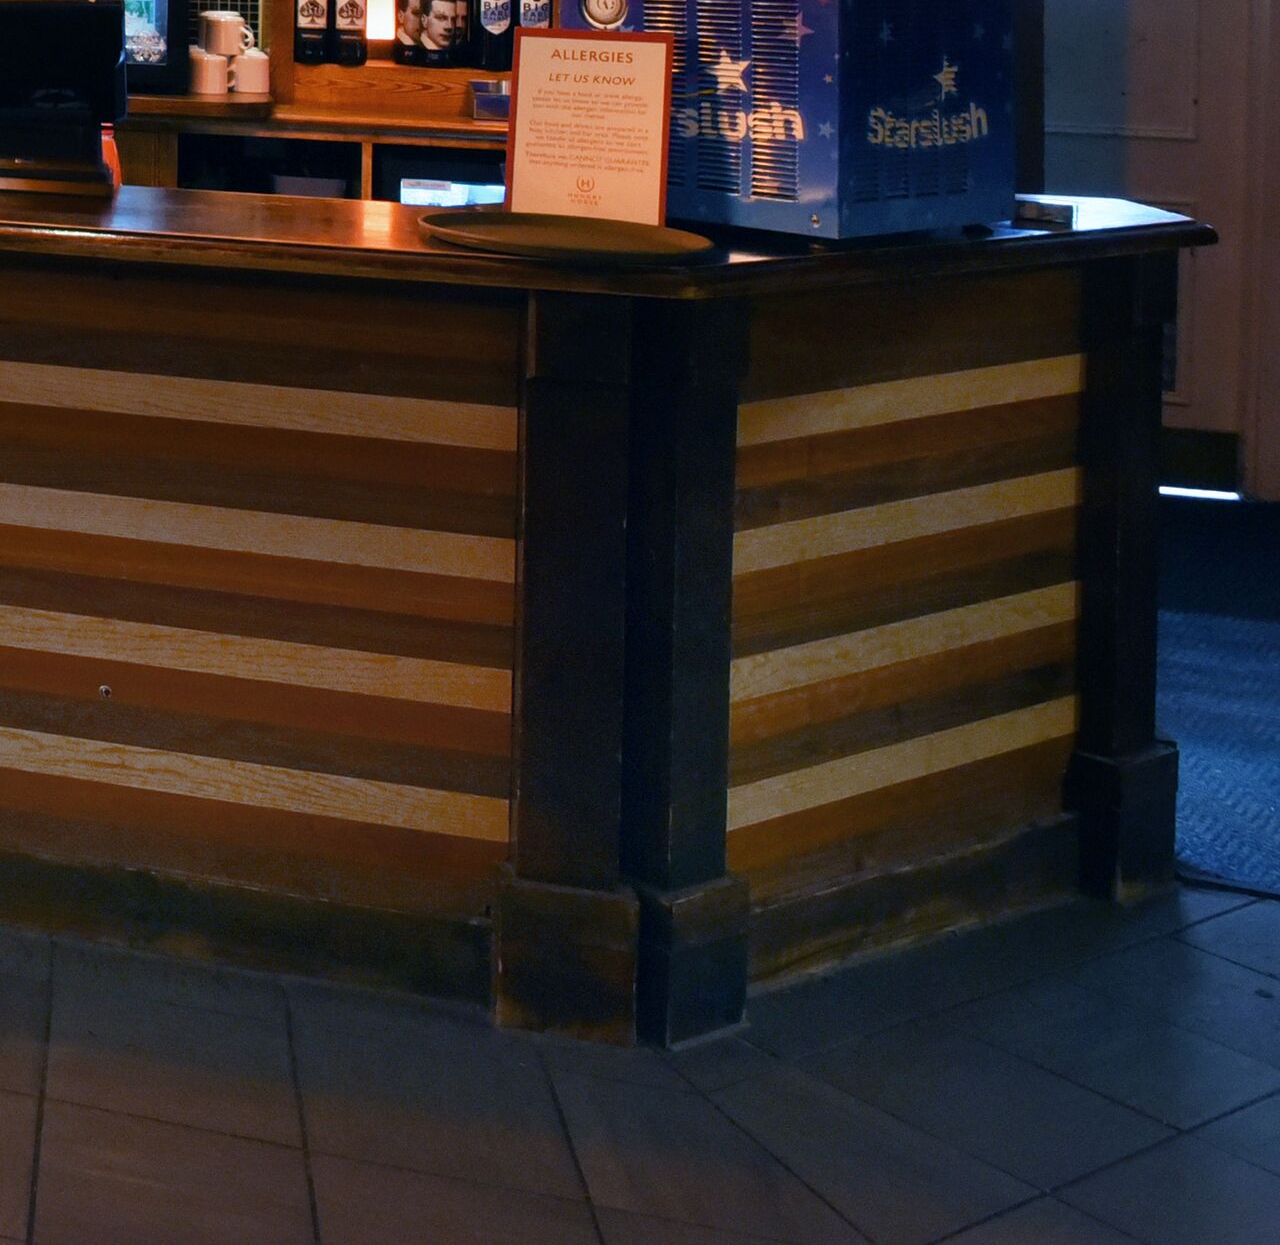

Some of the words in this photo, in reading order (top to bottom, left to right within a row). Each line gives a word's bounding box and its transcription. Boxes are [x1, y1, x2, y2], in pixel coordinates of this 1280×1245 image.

[483, 1, 509, 10] BIG
[523, 2, 549, 12] BIG
[551, 49, 633, 64] ALLERGIES
[549, 73, 570, 82] LET
[573, 74, 589, 83] US
[592, 75, 636, 85] KNOW
[866, 103, 988, 148] Starslush
